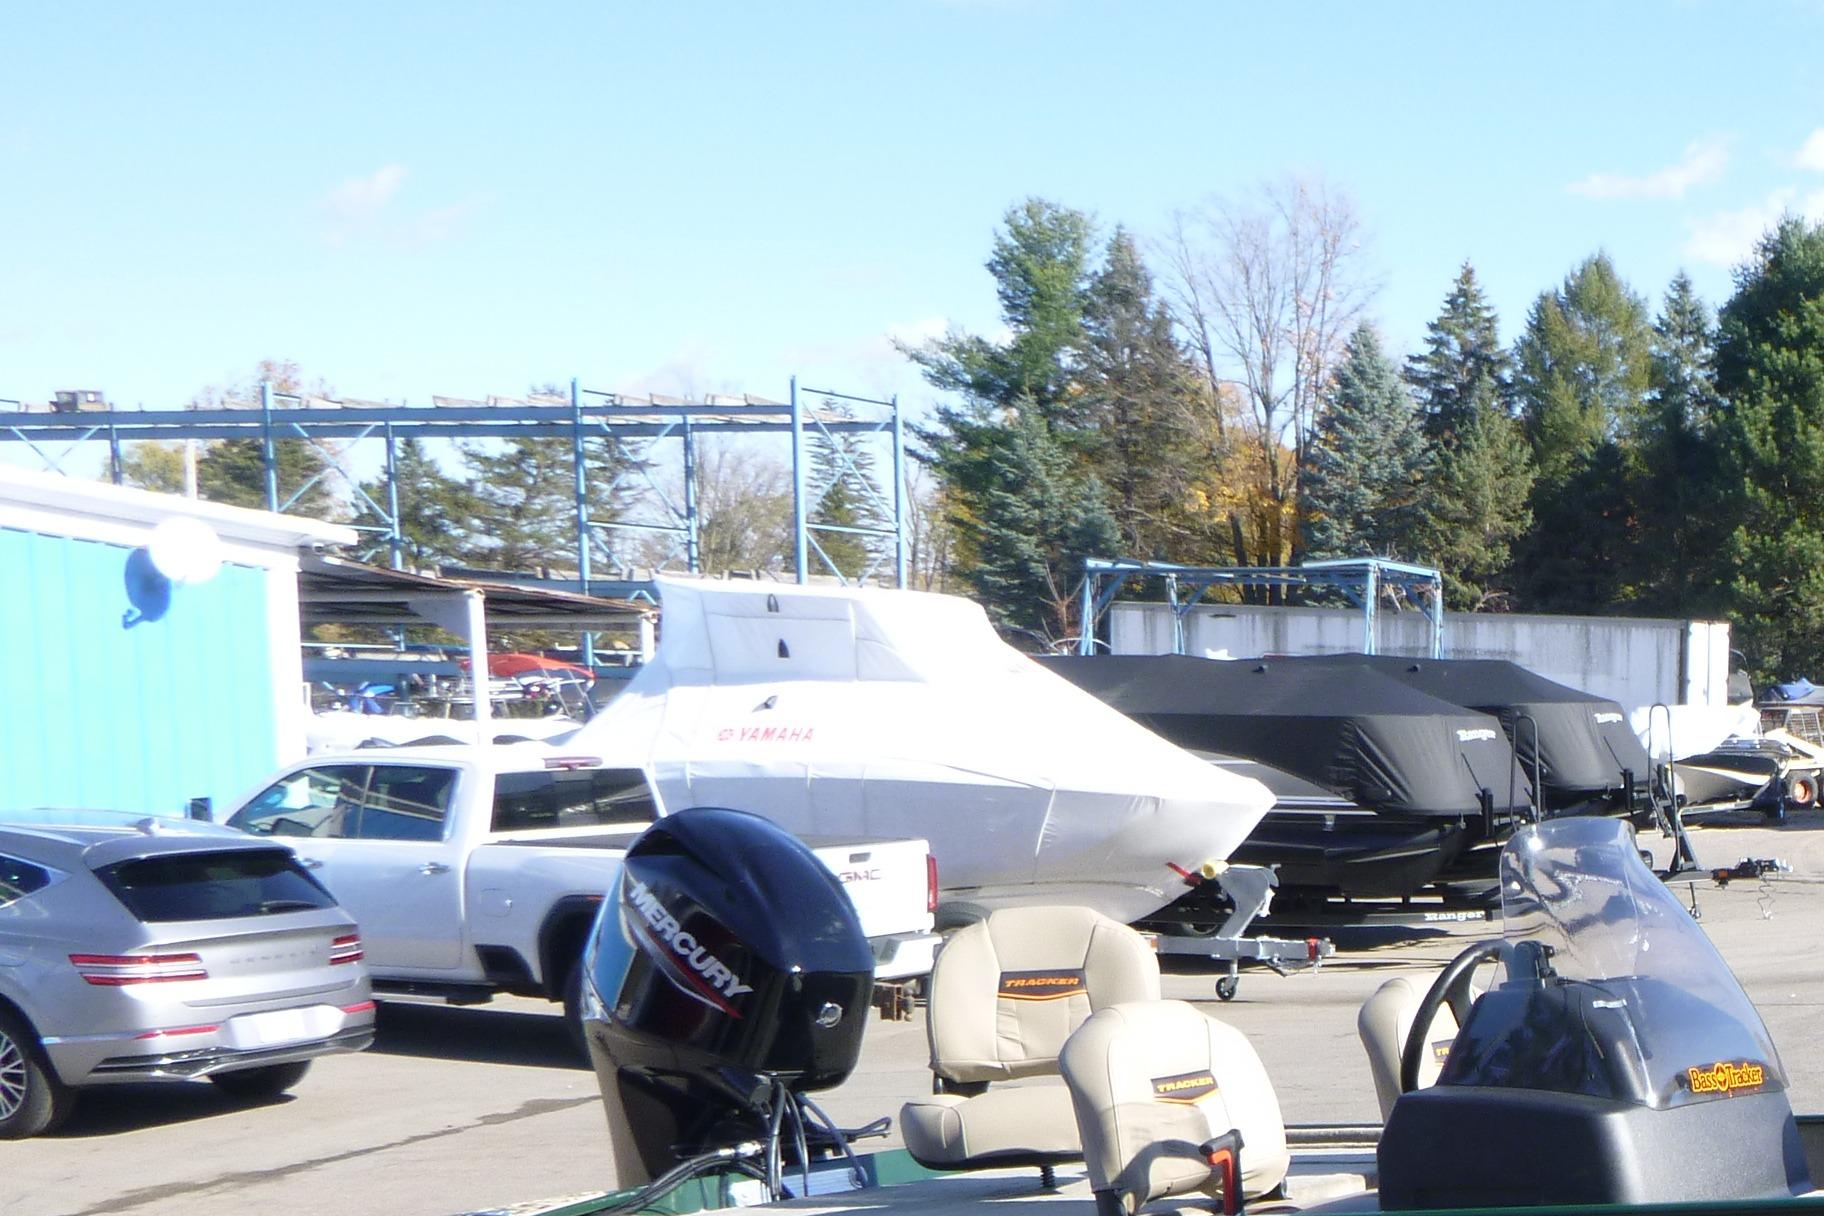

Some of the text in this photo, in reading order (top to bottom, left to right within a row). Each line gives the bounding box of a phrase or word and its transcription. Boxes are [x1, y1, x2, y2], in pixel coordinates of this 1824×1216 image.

[740, 727, 814, 742] YAMAHA
[839, 869, 881, 883] GMC
[1424, 910, 1485, 921] Ranger
[630, 882, 753, 998] MERCURY
[1004, 976, 1079, 988] TRACKER
[1157, 1077, 1214, 1093] TRACKER
[1689, 1063, 1763, 1092] Bass Tracker
